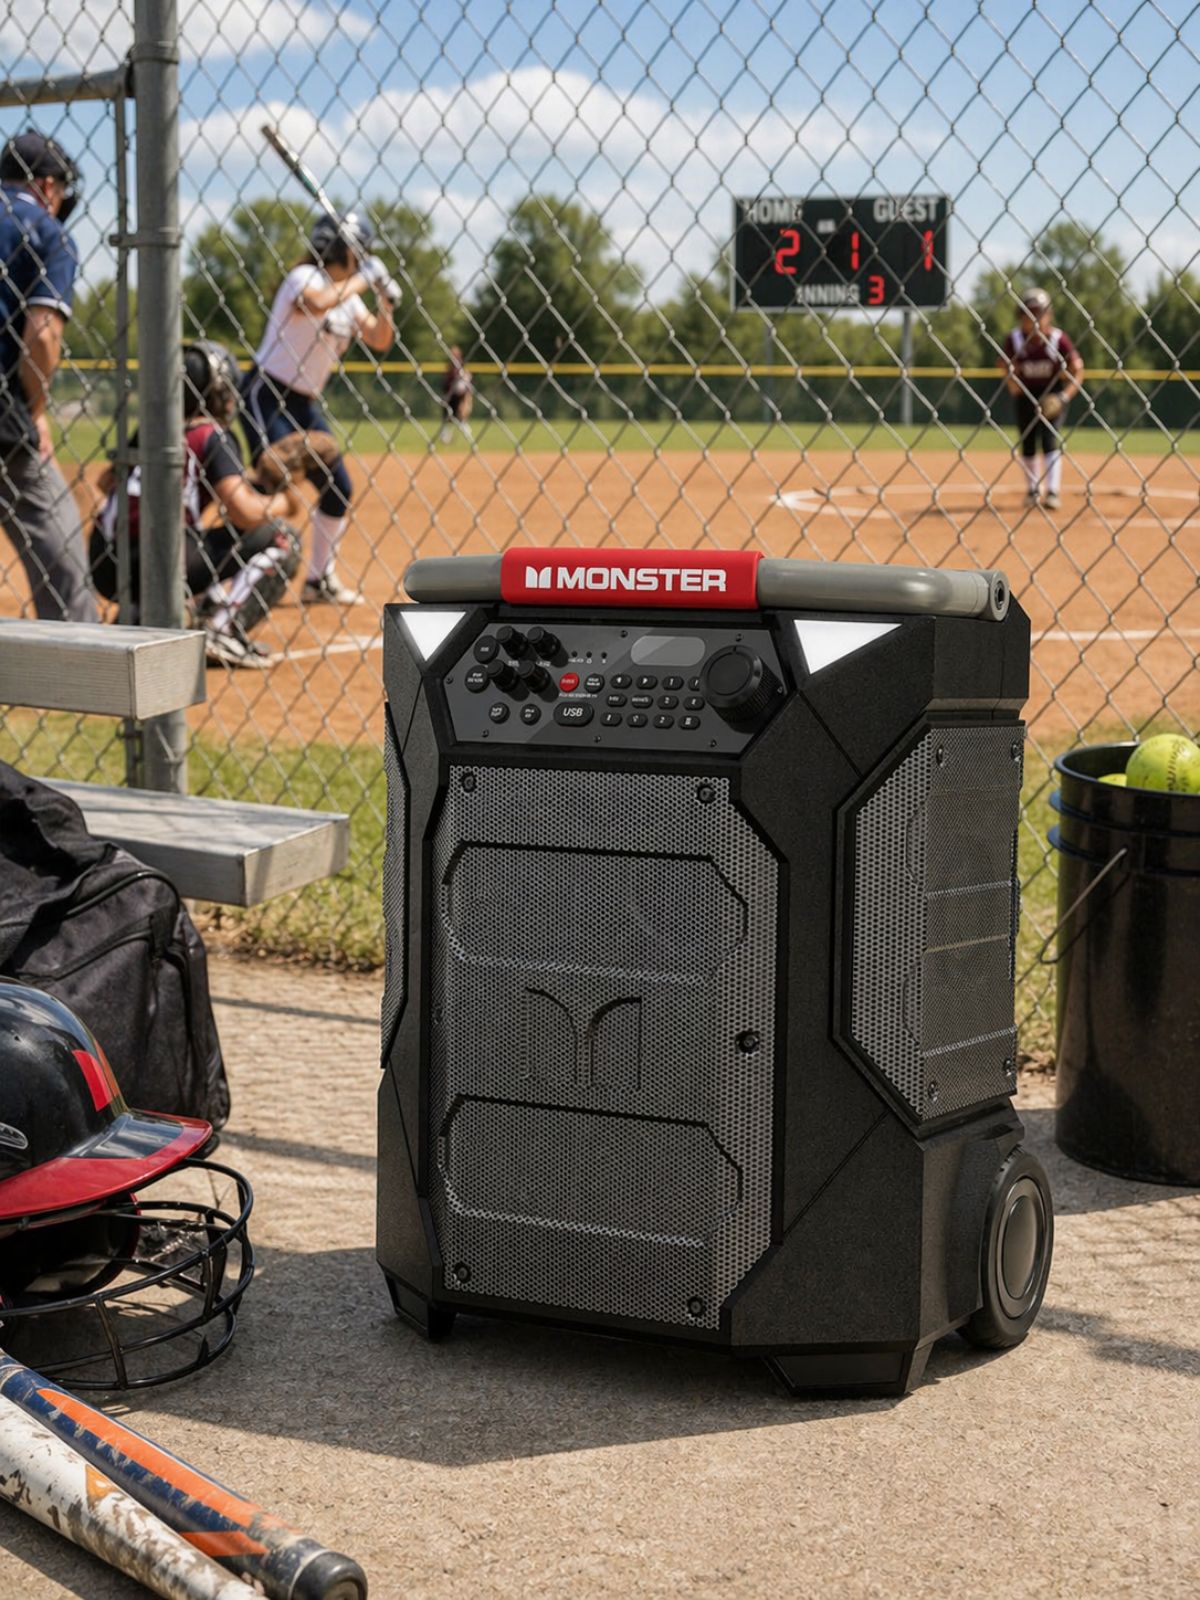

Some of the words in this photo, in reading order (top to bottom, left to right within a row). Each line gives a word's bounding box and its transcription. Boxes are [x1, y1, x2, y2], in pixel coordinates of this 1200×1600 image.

[873, 198, 939, 222] GUEST
[775, 228, 800, 274] 2
[851, 231, 859, 270] 1
[867, 275, 885, 305] 3
[557, 566, 727, 592] MONSTER
[563, 707, 583, 717] USB
